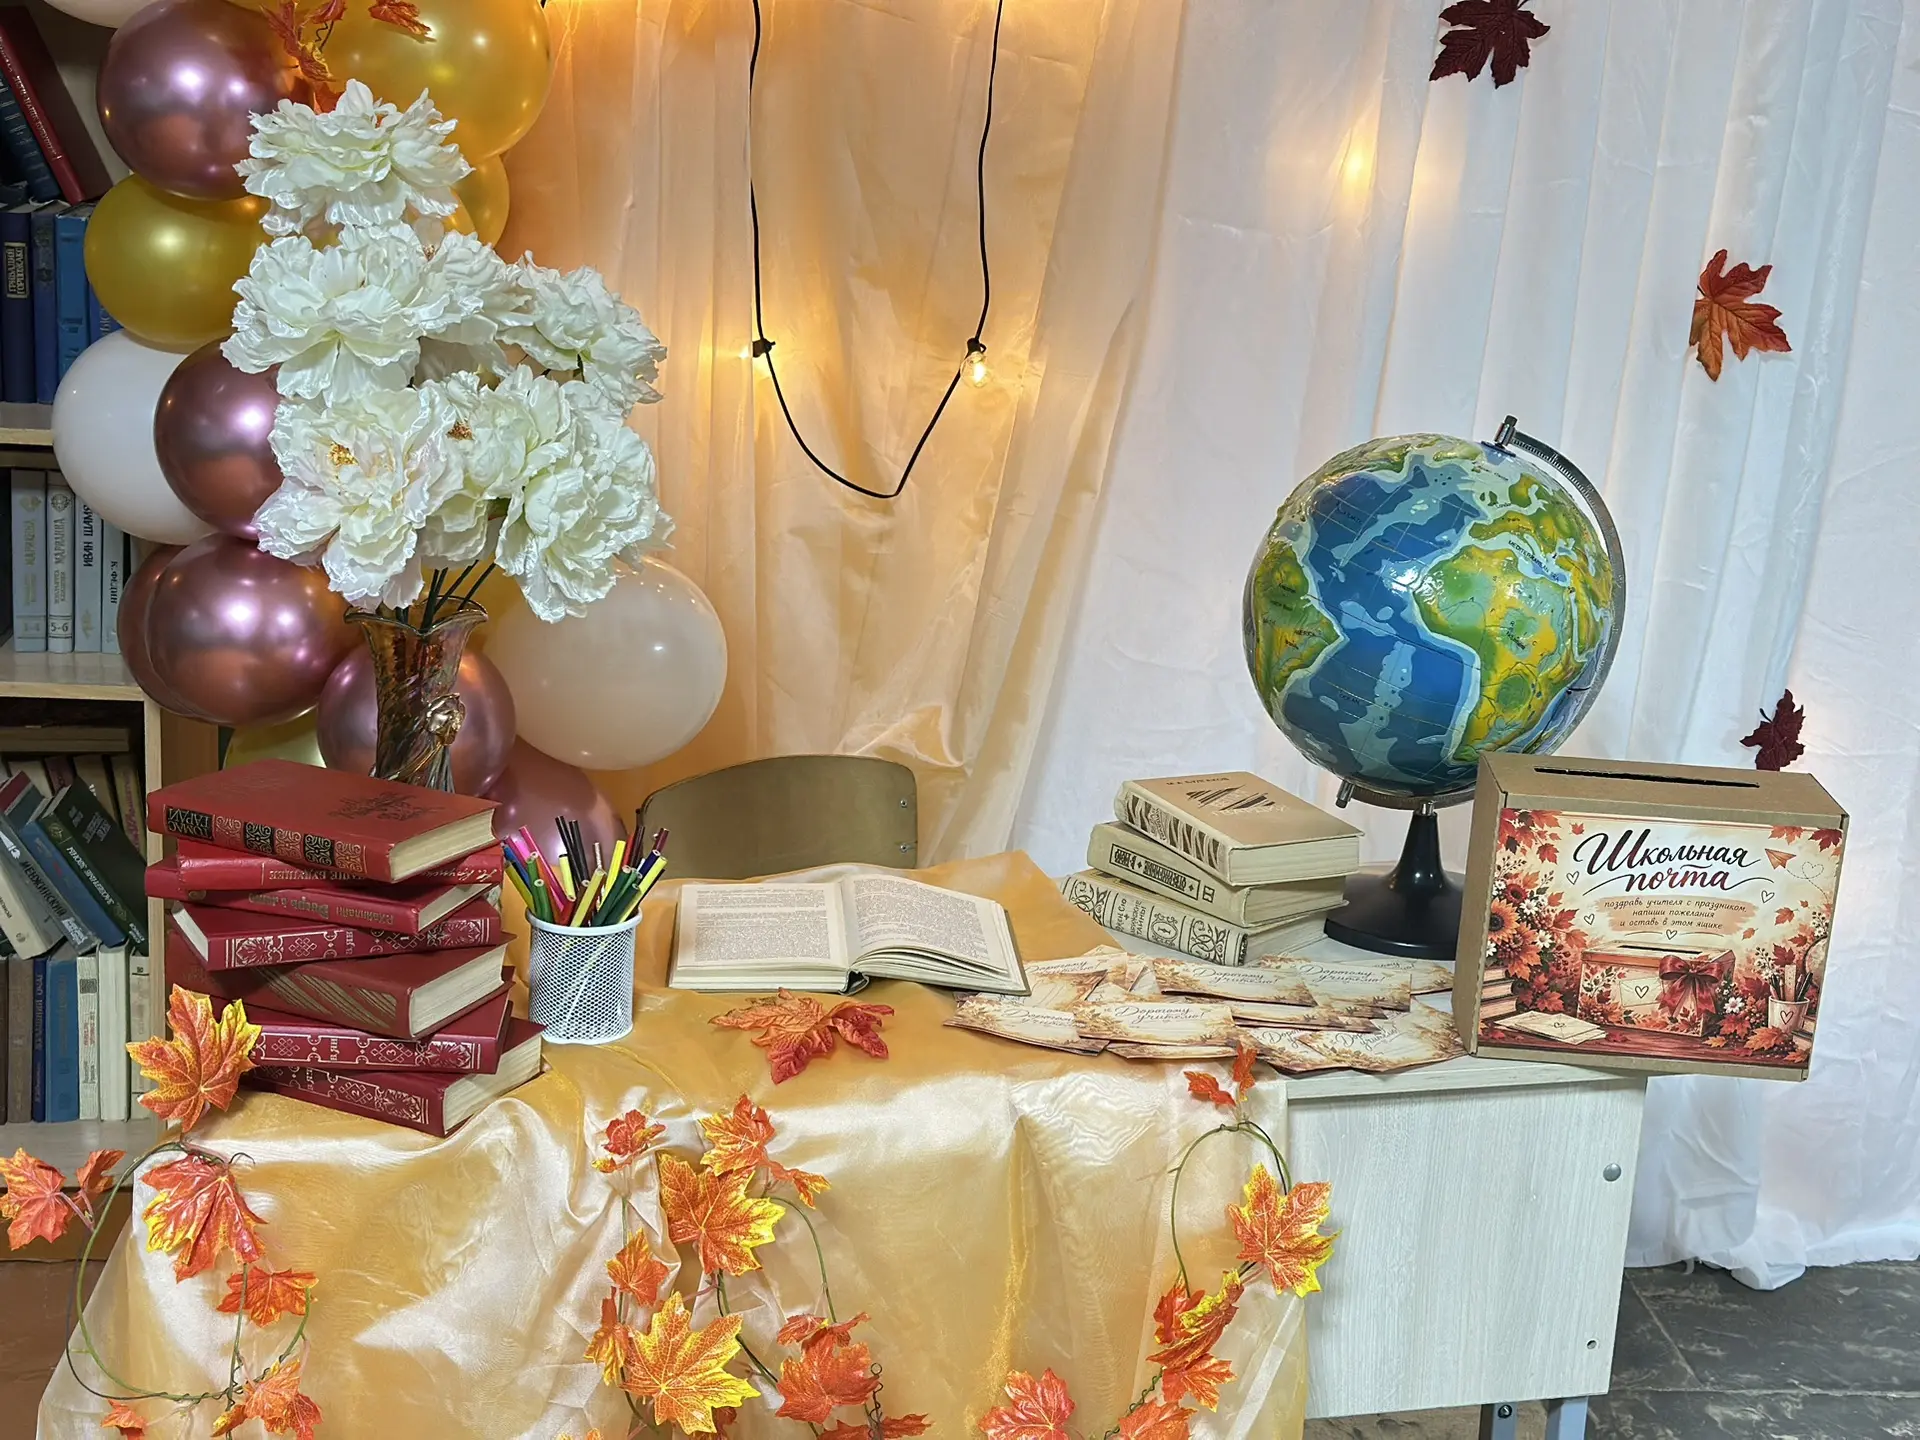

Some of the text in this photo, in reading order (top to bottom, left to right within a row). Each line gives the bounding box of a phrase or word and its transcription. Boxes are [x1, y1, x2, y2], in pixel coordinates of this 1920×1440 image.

[83, 504, 94, 567] ИВАН ШАМЯ
[51, 623, 69, 632] 5-6
[168, 808, 211, 829] ГАРДИ
[168, 820, 211, 839] ТОМАС
[1573, 829, 1761, 875] Школьная
[269, 869, 327, 881] БУДУЩЕЕ
[1584, 863, 1774, 895] почта
[22, 861, 68, 917] МЕНЖИНСКИЙ
[1604, 897, 1644, 909] поздравь
[1646, 899, 1683, 908] учителя
[1632, 909, 1715, 918] напиши пожелания
[1628, 917, 1659, 927] оставь
[1662, 917, 1667, 926] в
[1670, 919, 1693, 927] этом
[1695, 920, 1723, 930] ящике
[1193, 966, 1264, 980] Дорогому
[1300, 963, 1376, 978] Дорогому
[1214, 974, 1279, 985] учителю!
[1312, 971, 1385, 984] учителю!
[1115, 1005, 1193, 1017] Дорогому
[1137, 1012, 1205, 1025] учителю!
[330, 1038, 340, 1062] В.ЯН
